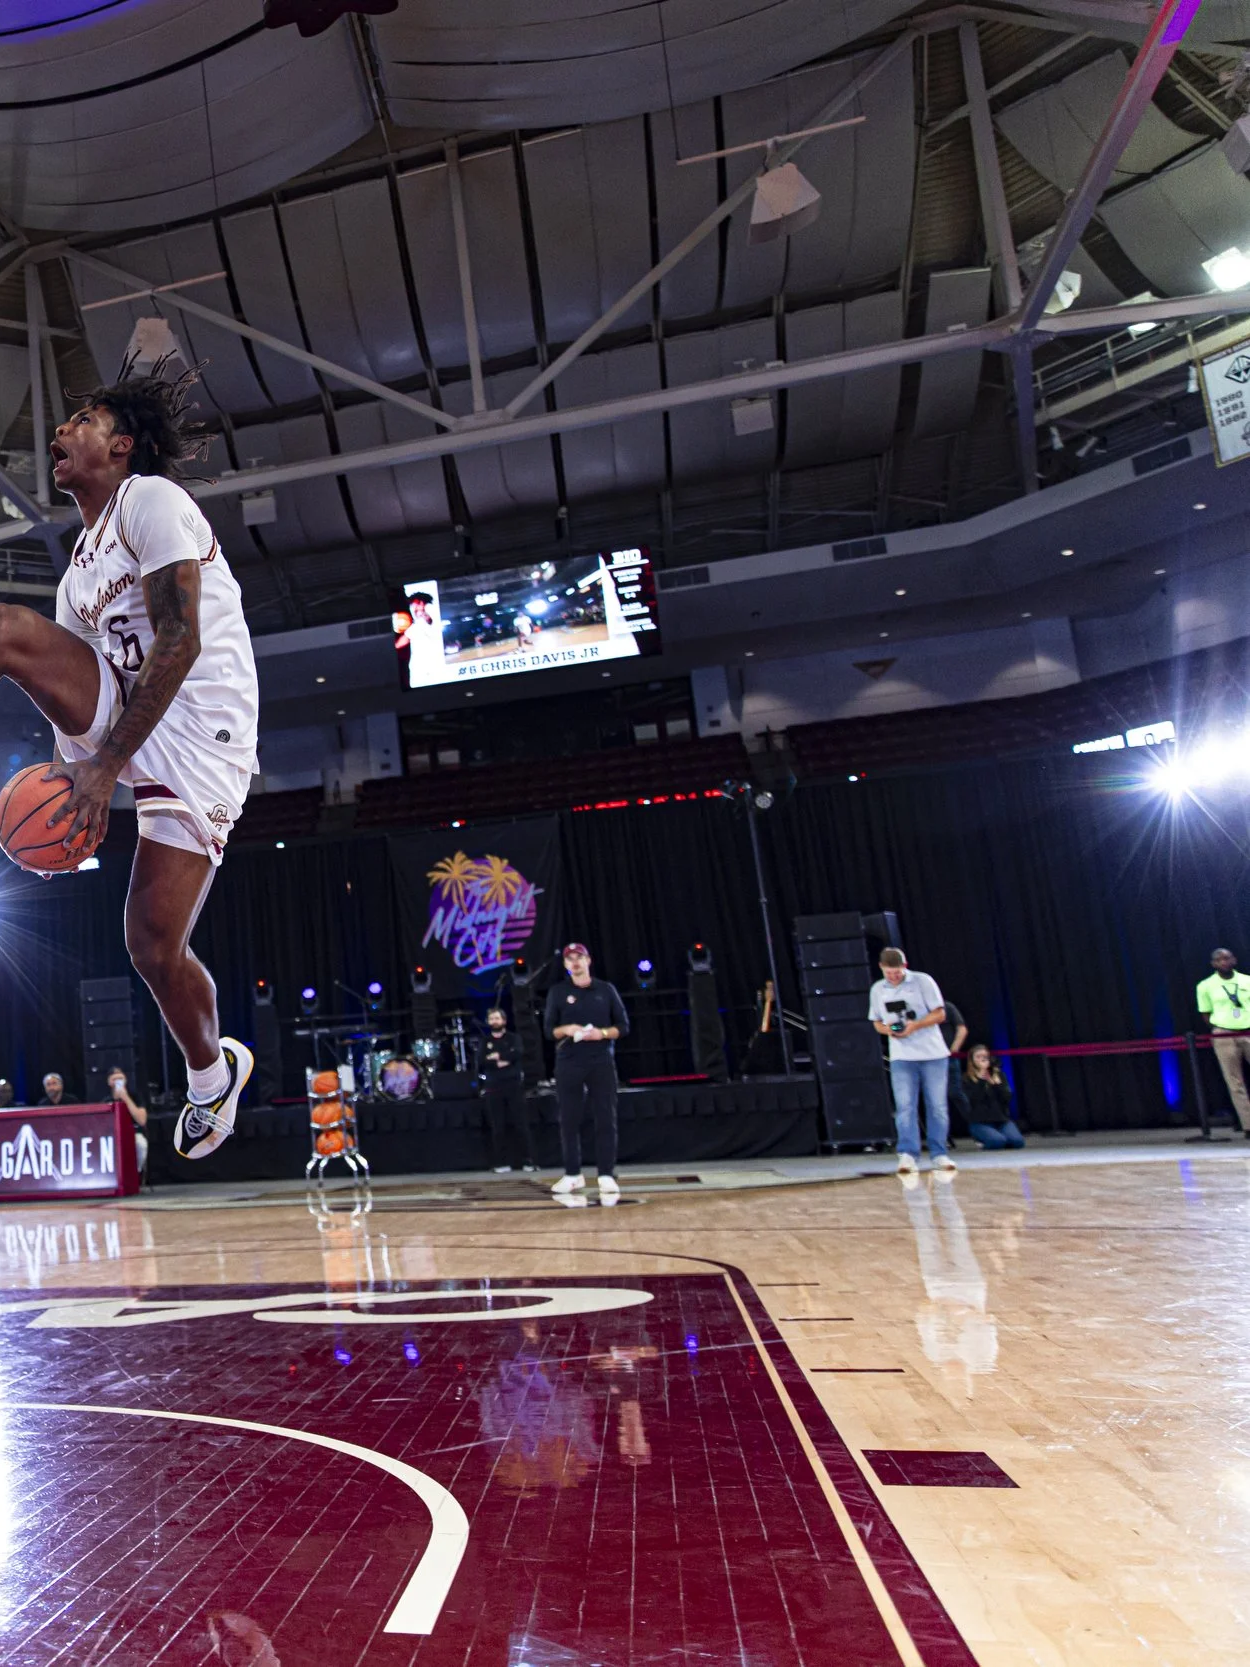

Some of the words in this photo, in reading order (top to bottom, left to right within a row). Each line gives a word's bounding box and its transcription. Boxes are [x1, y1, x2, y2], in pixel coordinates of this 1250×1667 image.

[109, 615, 144, 672] 6
[481, 658, 526, 673] CHRIS
[531, 650, 576, 666] DAVIS
[580, 647, 600, 659] JR
